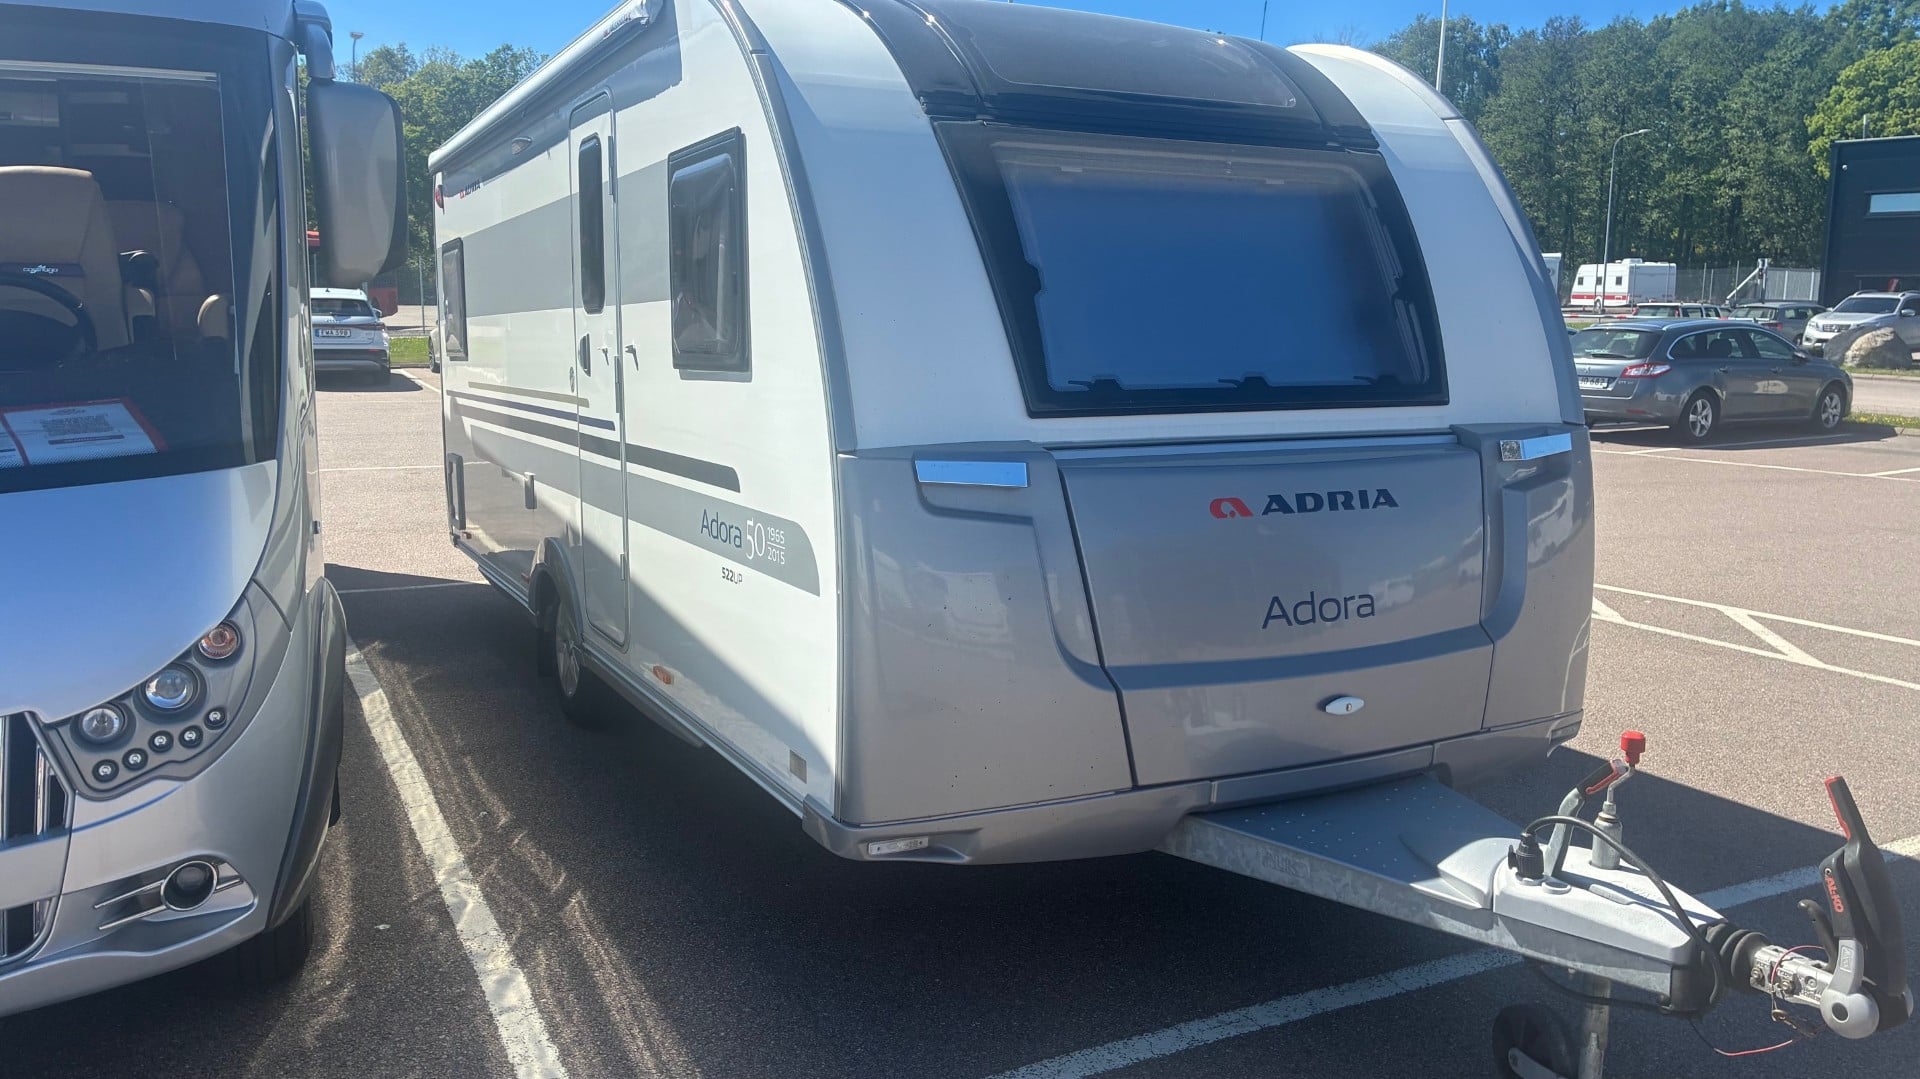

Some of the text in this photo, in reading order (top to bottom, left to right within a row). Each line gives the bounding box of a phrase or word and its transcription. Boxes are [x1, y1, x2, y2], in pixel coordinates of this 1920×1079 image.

[1261, 487, 1400, 517] ADRIA
[700, 508, 785, 561] Adora 50 1965
[767, 546, 785, 565] 2015
[1261, 590, 1377, 630] Adora
